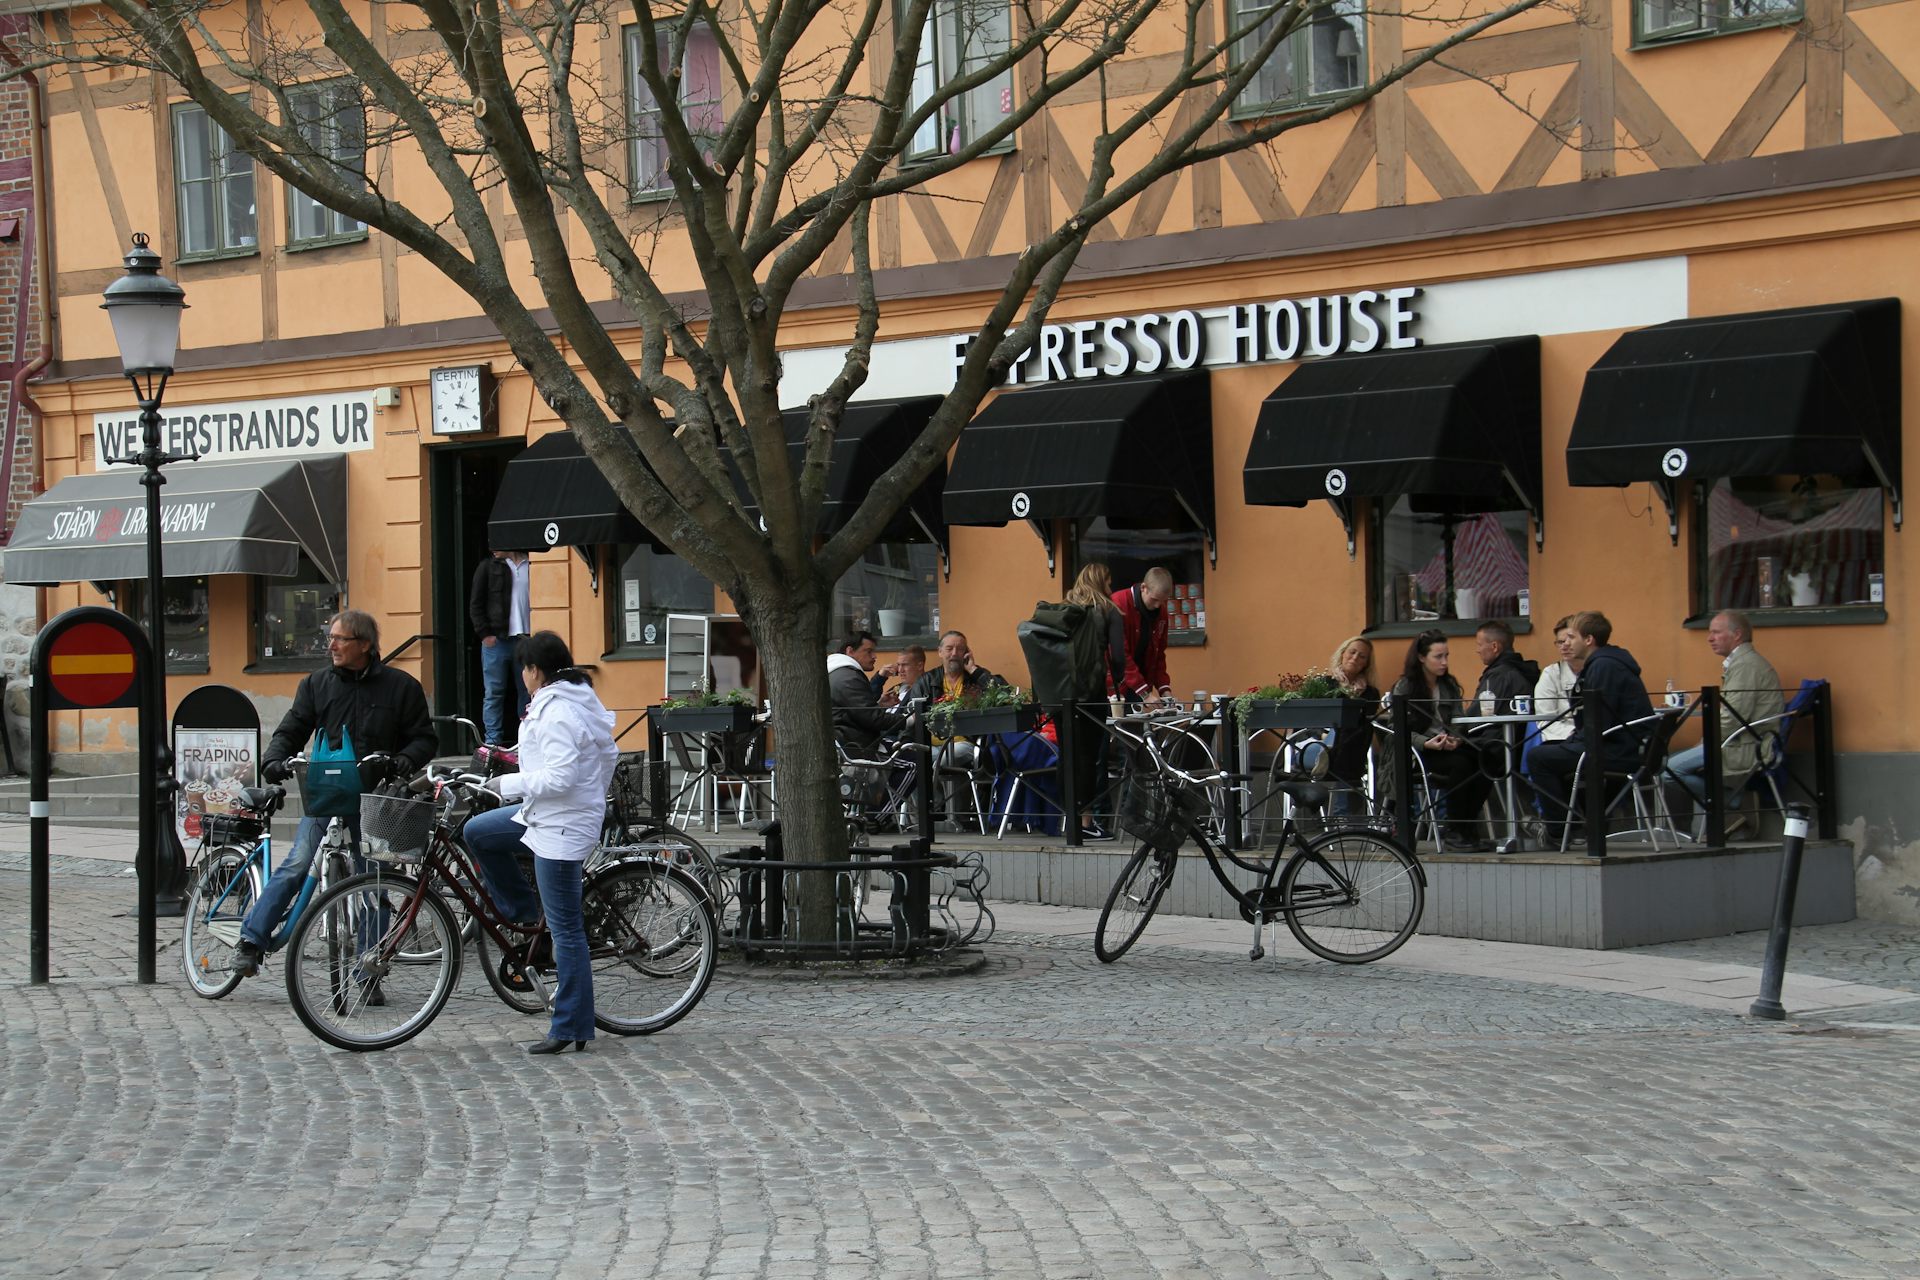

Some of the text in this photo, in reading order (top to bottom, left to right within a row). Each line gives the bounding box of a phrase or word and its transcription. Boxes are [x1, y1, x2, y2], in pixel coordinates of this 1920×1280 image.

[1228, 287, 1421, 363] HOUSE
[332, 402, 369, 445] UR
[183, 748, 250, 762] FRAPINO
